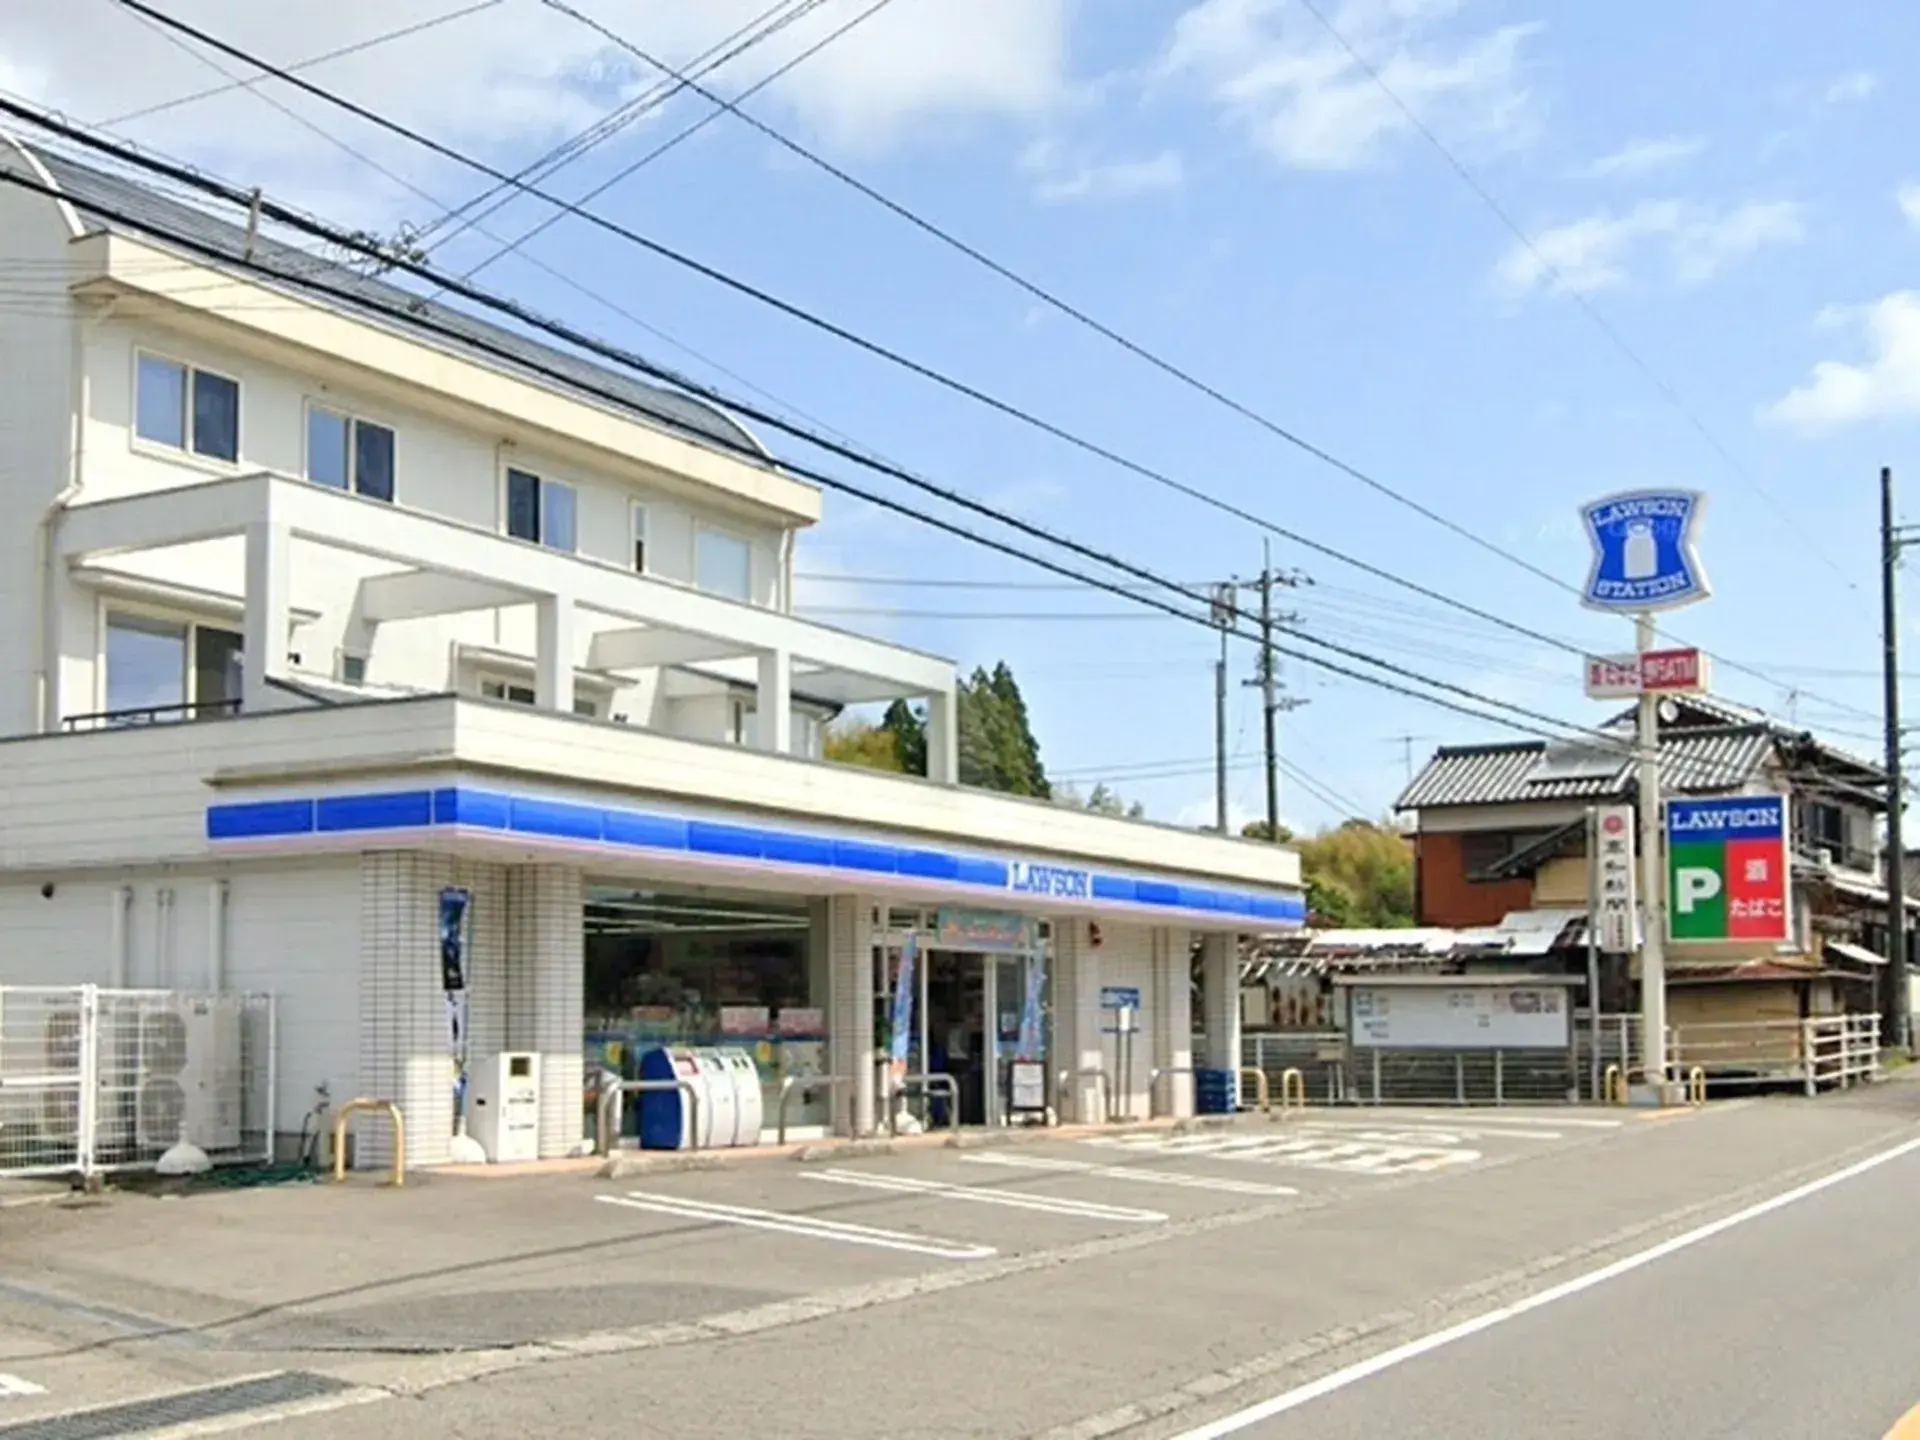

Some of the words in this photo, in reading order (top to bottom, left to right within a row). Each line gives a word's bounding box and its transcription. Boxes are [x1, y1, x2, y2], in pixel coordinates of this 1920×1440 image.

[1593, 499, 1687, 526] LAWSON
[1596, 570, 1687, 597] STATION
[1672, 808, 1778, 831] LAWSON
[1009, 861, 1091, 900] LAWSON
[1676, 867, 1723, 915] P
